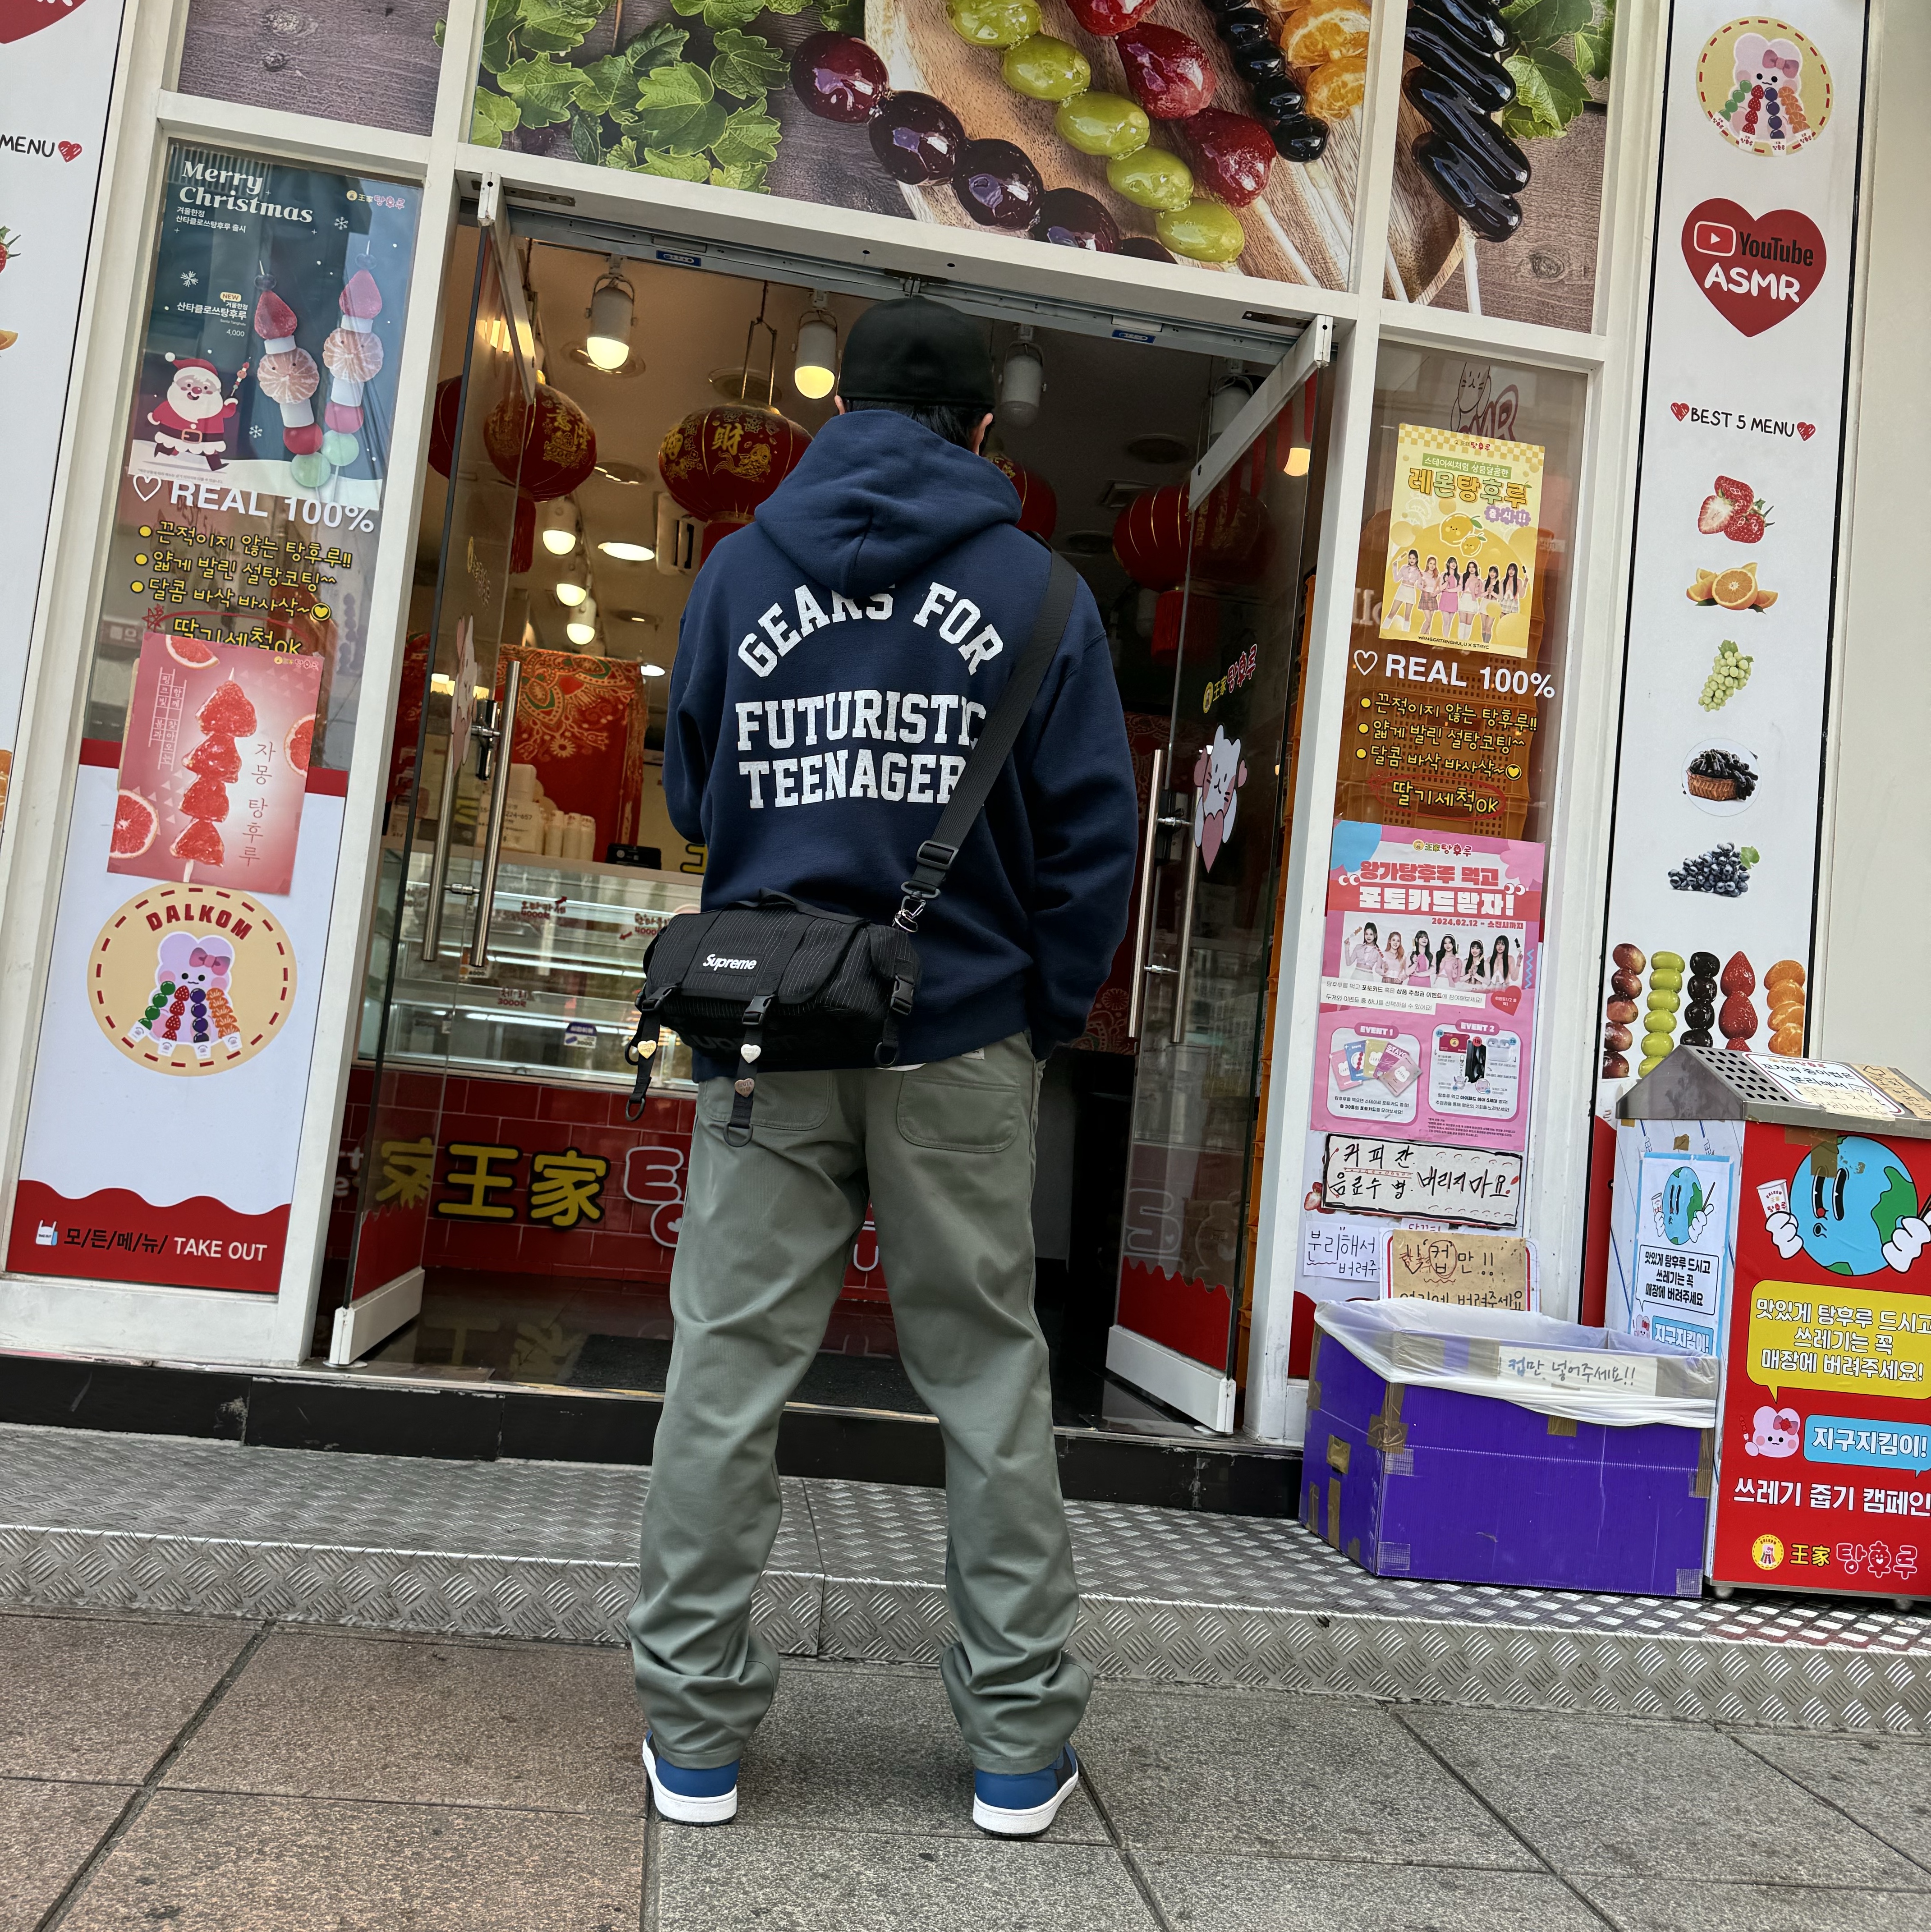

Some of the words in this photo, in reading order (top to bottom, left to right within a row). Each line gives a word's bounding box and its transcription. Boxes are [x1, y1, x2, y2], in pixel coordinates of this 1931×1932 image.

[0, 134, 55, 158] MENU
[181, 161, 263, 195] Merry
[176, 207, 205, 217] 겨울한정
[179, 186, 313, 223] Christmas
[374, 195, 405, 209] 탕후루
[176, 215, 231, 230] 산타클로쓰탕후루
[232, 224, 246, 233] 출시
[1739, 231, 1814, 267] YouTube
[1703, 262, 1801, 303] ASMR
[177, 302, 247, 320] 산타클로쓰탕후루
[1691, 406, 1732, 429] BEST
[1736, 414, 1747, 430] 5
[1751, 418, 1795, 438] MENU
[1470, 442, 1491, 451] 탕후루
[1424, 456, 1469, 472] 스테이씨처럼
[1471, 463, 1509, 477] 상큼달콤한
[1408, 468, 1527, 509] 레몬탕후루
[170, 479, 268, 517] REAL
[284, 496, 374, 533] 100%
[156, 521, 234, 550] 끈적이지
[241, 535, 279, 559] 않는
[285, 541, 353, 569] 탕후루!!
[153, 551, 192, 572] 얇게
[197, 558, 237, 580] 발린
[149, 578, 188, 604] 달콤
[193, 589, 234, 608] 바삭
[913, 582, 1004, 676] FOR
[1227, 643, 1257, 693] 탕후루
[1385, 653, 1468, 688] REAL
[1479, 666, 1555, 698] 100%
[1375, 693, 1440, 718] 끈적이지
[1445, 703, 1477, 725] 않는
[1482, 708, 1537, 731] 탕후루!!
[1373, 720, 1405, 740] 얇게
[1410, 725, 1442, 746] 발린
[251, 741, 276, 785] 자몽
[1371, 745, 1403, 768] 달콤
[1408, 753, 1442, 771] 바삭
[738, 749, 967, 809] TEENAGER
[238, 797, 269, 867] 탕후루
[1441, 844, 1472, 857] 탕후루
[1360, 860, 1456, 884] 왕가탕후루
[1461, 867, 1499, 887] 먹고
[1359, 886, 1515, 916] 포토카드받자!
[145, 903, 254, 941] DALKOM
[1431, 917, 1478, 927] 2024.02.12
[702, 953, 757, 971] Supreme
[1360, 1025, 1388, 1036] EVENT
[1460, 1022, 1488, 1032] EVENT
[439, 1143, 607, 1227] 王家
[1330, 1171, 1382, 1199] 음료수
[174, 1237, 223, 1258] TAKE
[228, 1241, 268, 1262] OUT
[1644, 1251, 1664, 1267] 맛있게
[1665, 1254, 1686, 1270] 탕후루
[1688, 1258, 1711, 1274] 드시고
[1656, 1269, 1685, 1286] 쓰레기는
[1686, 1274, 1694, 1288] 꼭
[1645, 1283, 1665, 1299] 매장에
[1667, 1287, 1703, 1307] 버려주세요
[1756, 1298, 1813, 1324] 맛있게
[1817, 1304, 1873, 1329] 탕후루
[1879, 1311, 1931, 1335] 드시고
[1793, 1328, 1870, 1354] 쓰레기는
[1875, 1334, 1894, 1356] 꼭
[1761, 1349, 1816, 1374] 매장에
[1823, 1354, 1924, 1382] 버려주세요!
[1812, 1426, 1928, 1459] 지구지킴이!
[1733, 1477, 1801, 1508] 쓰레기
[1810, 1482, 1854, 1512] 줍기
[1862, 1487, 1931, 1517] 캠페인
[1789, 1543, 1831, 1567] 王家
[1836, 1540, 1918, 1580] 탕후루
